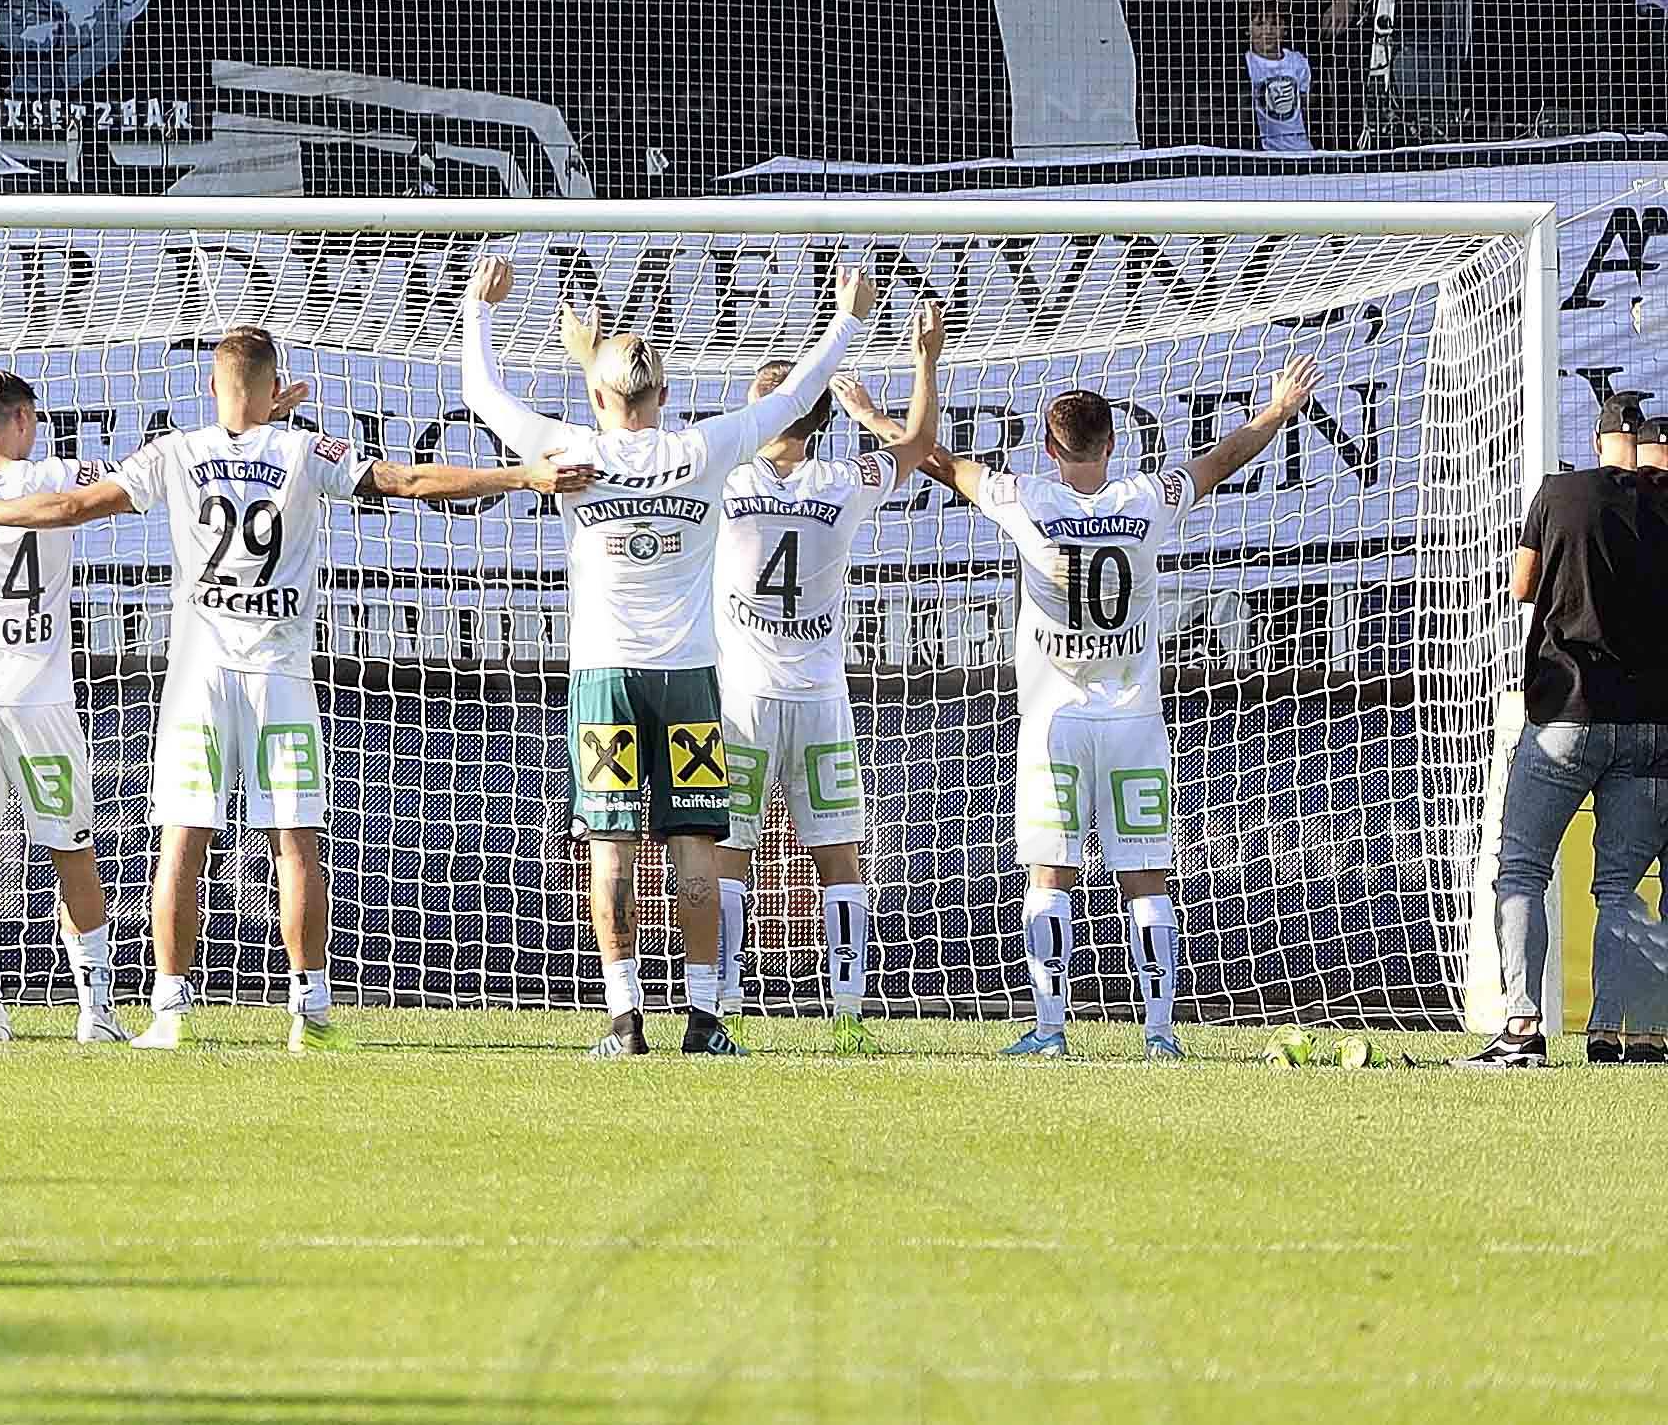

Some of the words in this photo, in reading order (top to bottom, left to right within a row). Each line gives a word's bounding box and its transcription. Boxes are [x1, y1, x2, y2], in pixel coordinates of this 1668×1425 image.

[197, 495, 284, 587] 29
[574, 495, 711, 526] PUNTIGAMER
[724, 495, 841, 527] PUNTIGAMER
[754, 530, 804, 619] 4
[1057, 543, 1133, 631] 10
